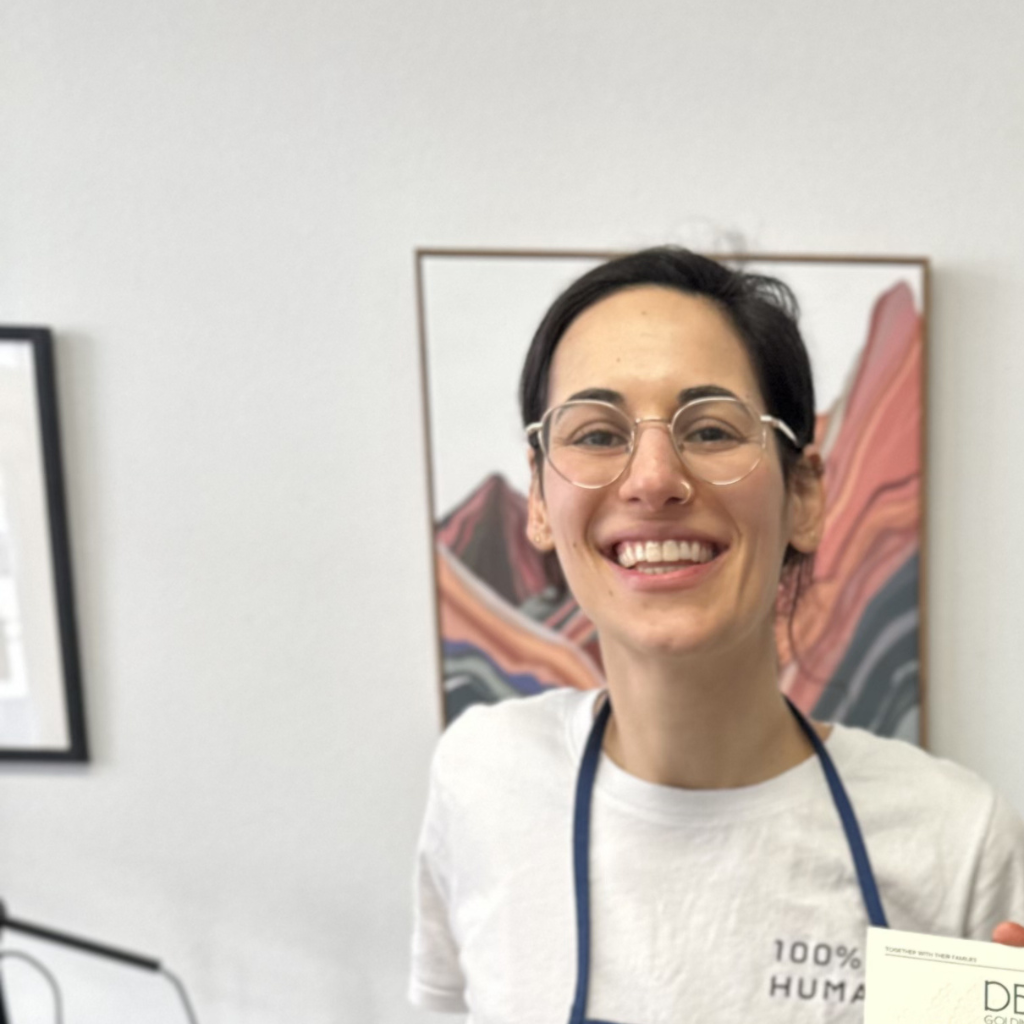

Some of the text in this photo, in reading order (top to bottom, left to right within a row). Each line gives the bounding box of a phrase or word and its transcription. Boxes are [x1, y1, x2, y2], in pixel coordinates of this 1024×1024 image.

[775, 939, 862, 969] 100%
[885, 946, 978, 963] TOGETHER WITH THEIR FAMILIES
